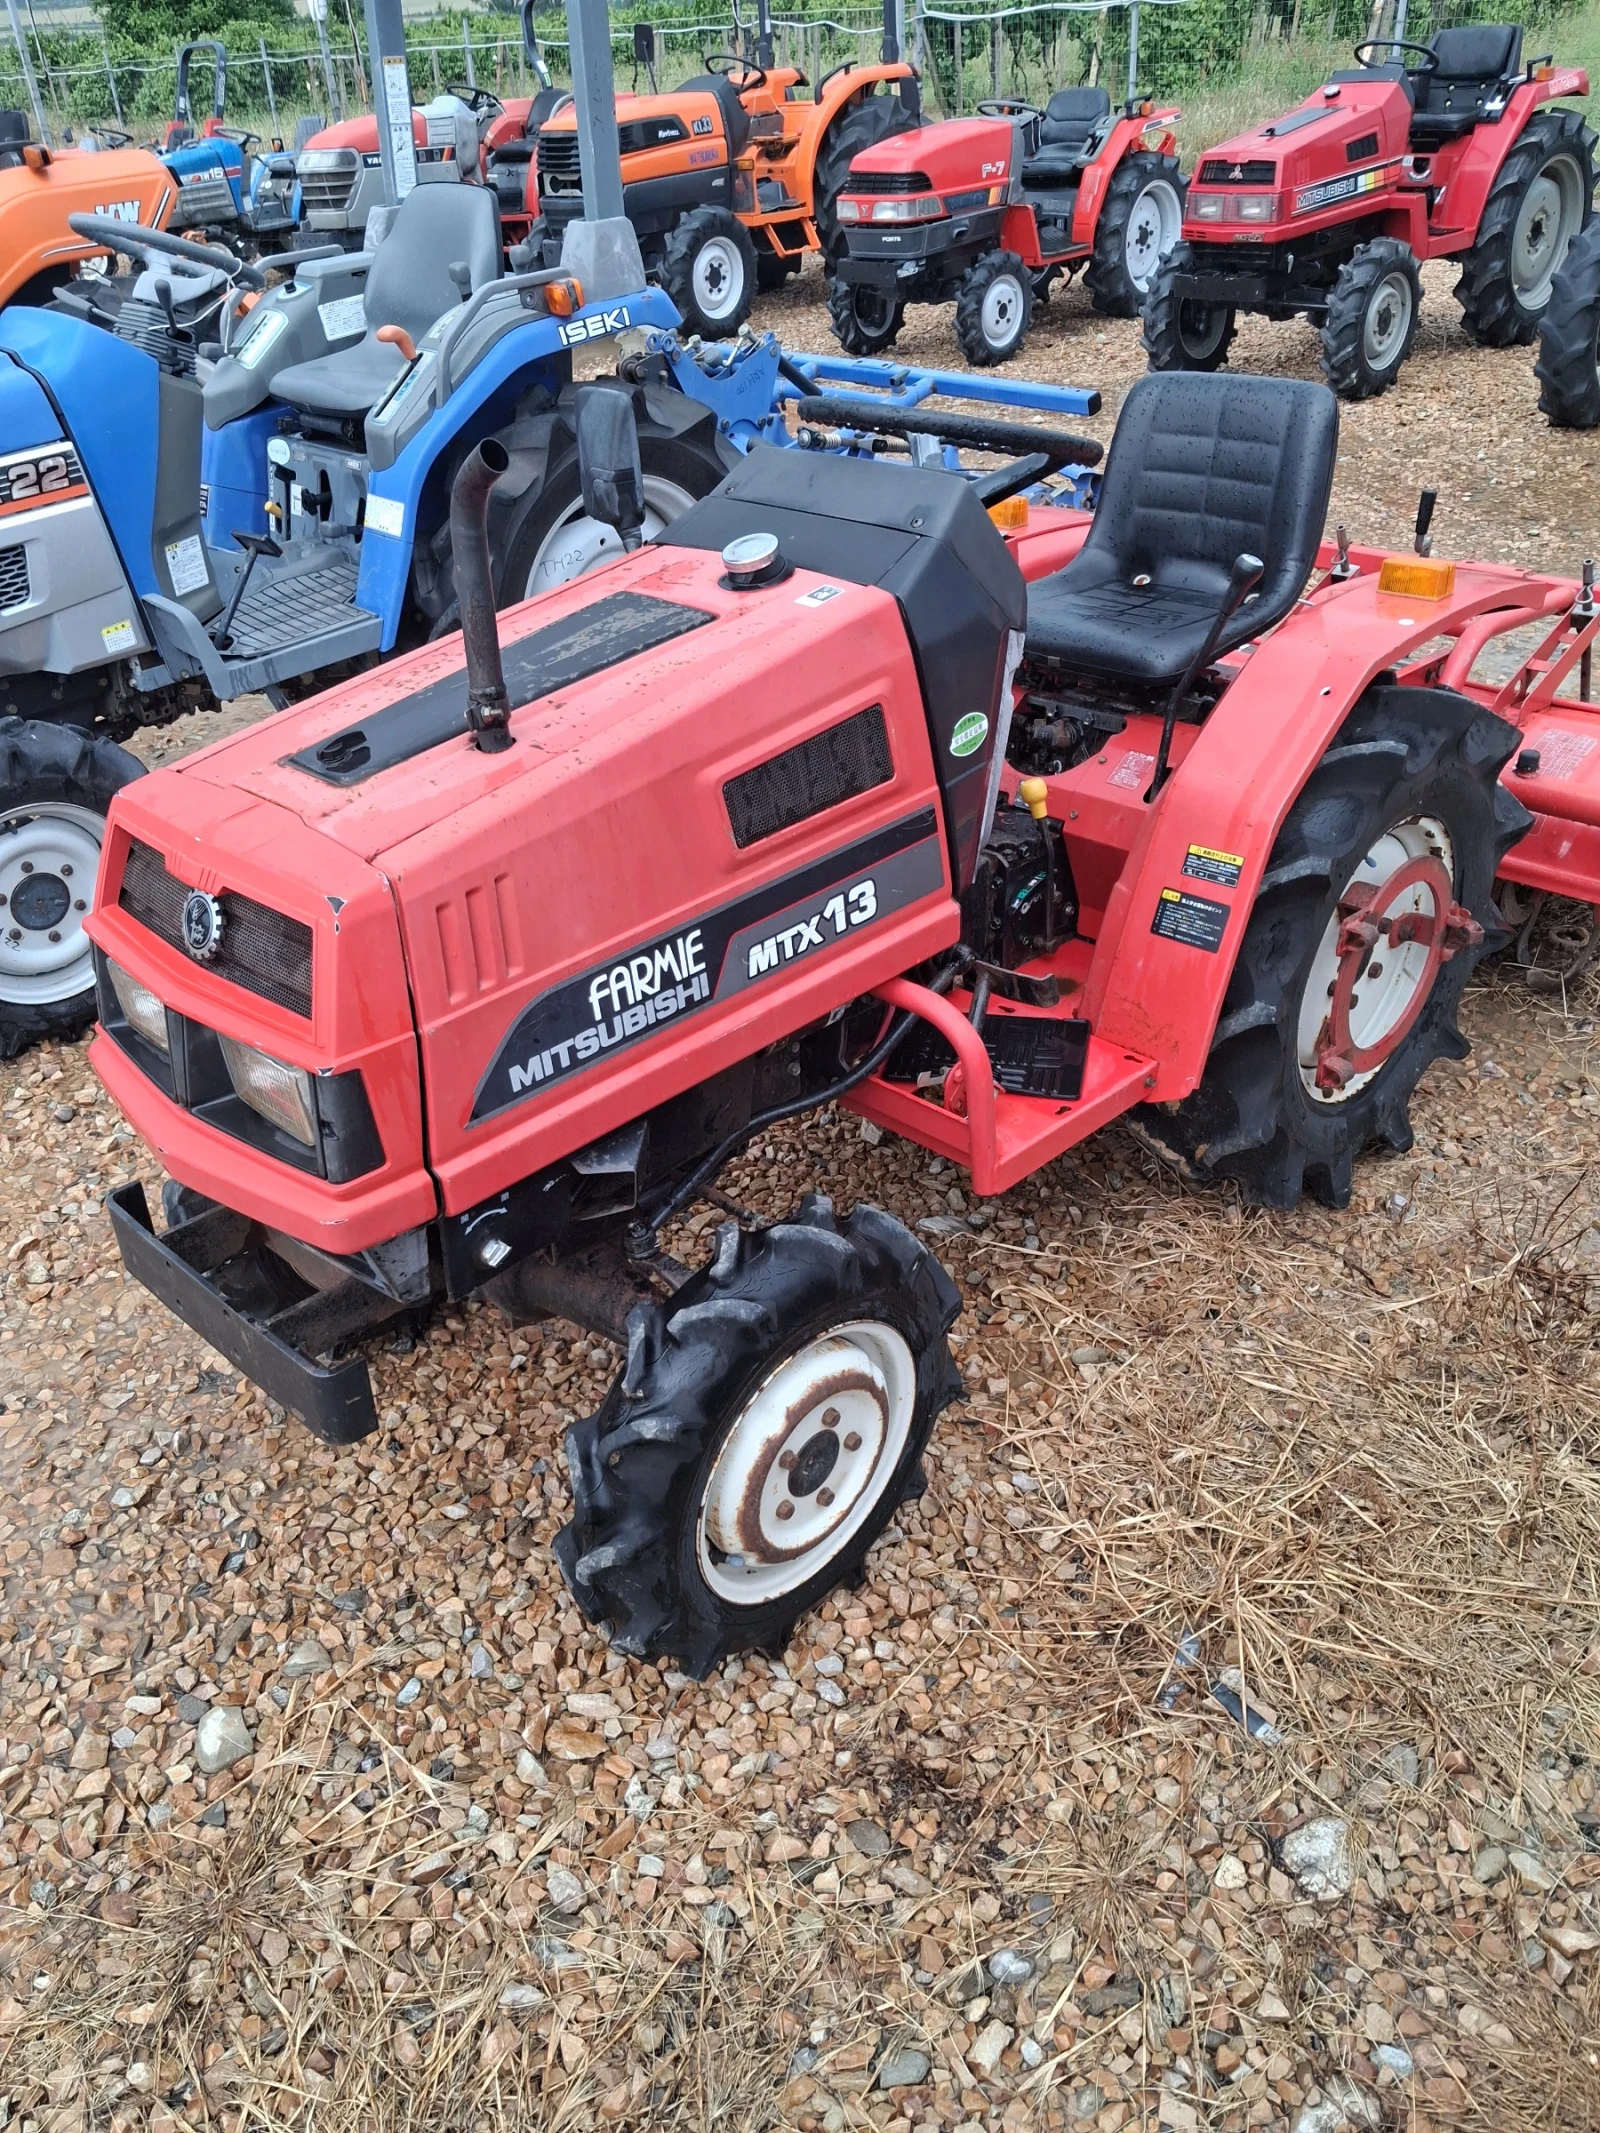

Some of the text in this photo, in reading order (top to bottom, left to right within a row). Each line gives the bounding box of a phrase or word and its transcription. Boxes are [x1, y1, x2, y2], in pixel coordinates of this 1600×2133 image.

[1296, 178, 1355, 208] MITSUBISHI
[558, 307, 631, 346] ISEKI
[540, 549, 585, 577] TH22
[588, 929, 706, 1022] FARMIE
[508, 973, 710, 1093] MITSUBISHI
